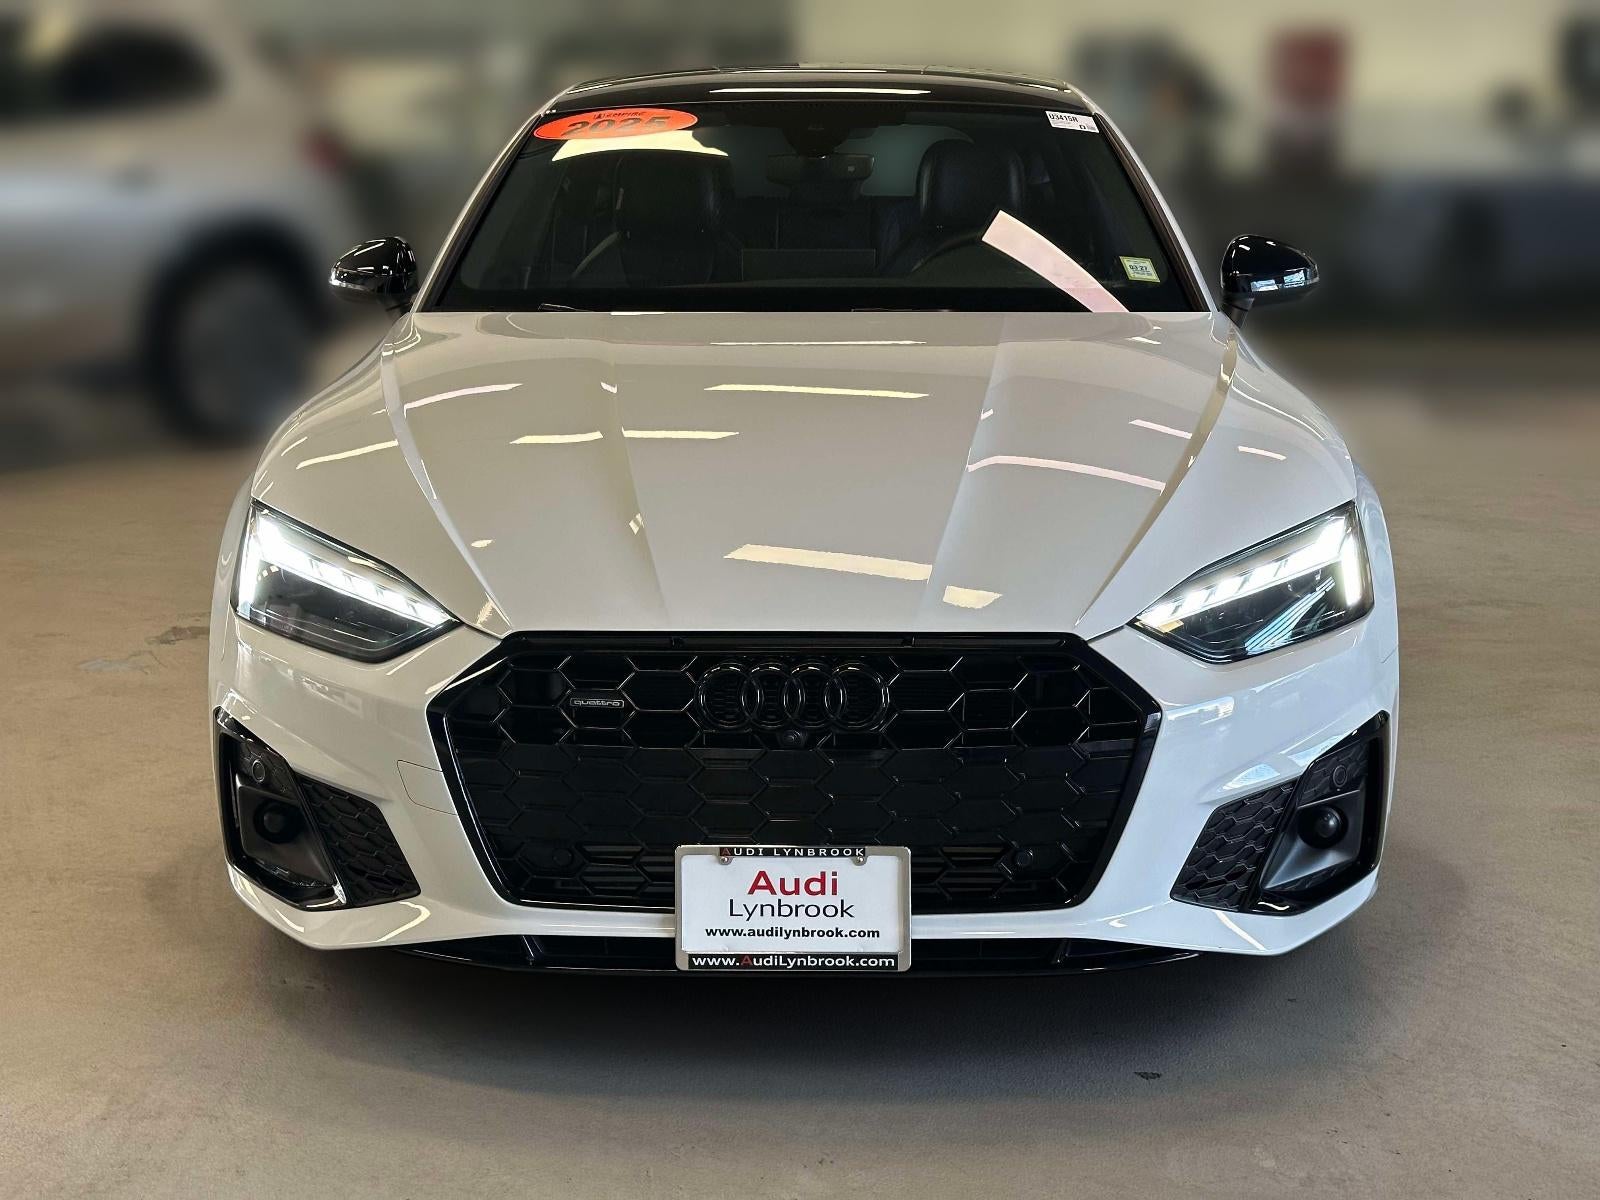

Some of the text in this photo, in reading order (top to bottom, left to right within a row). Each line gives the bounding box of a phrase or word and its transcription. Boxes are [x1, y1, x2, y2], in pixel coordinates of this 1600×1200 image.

[560, 116, 672, 136] 2025
[721, 847, 865, 857] AUDI LYNBROOK
[747, 870, 839, 896] Audi
[729, 898, 855, 922] Lynbrook
[705, 926, 881, 940] www.audilynbrook.com
[692, 955, 896, 970] www.AudiLynbrook.com
